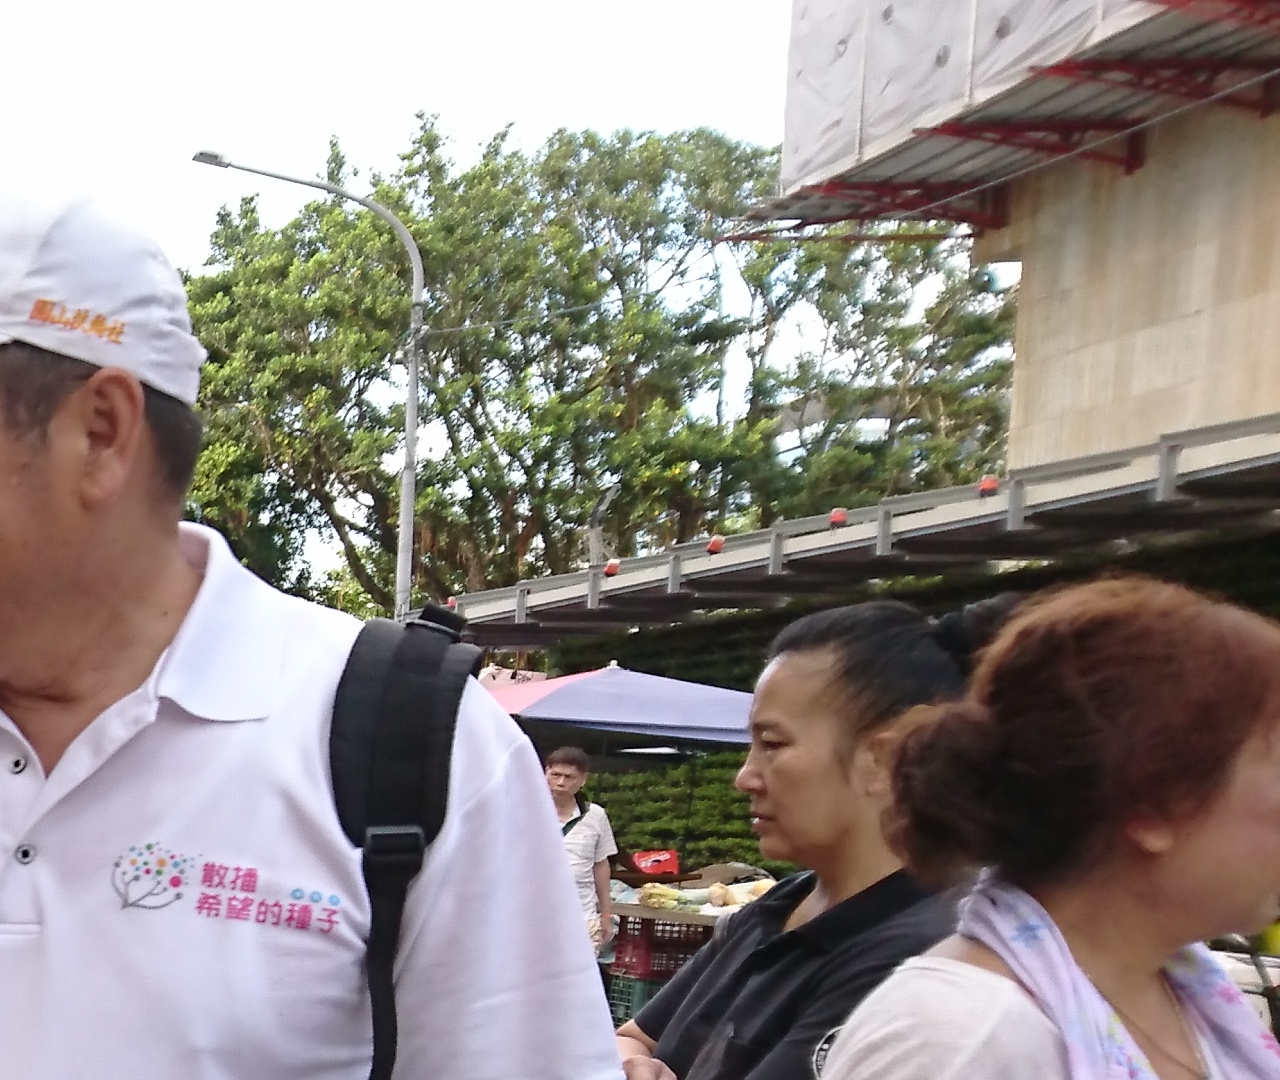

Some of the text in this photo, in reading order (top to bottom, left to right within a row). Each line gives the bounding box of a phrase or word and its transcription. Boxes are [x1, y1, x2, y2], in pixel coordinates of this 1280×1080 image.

[202, 862, 258, 893] 散播
[196, 892, 339, 934] 希望的種子
